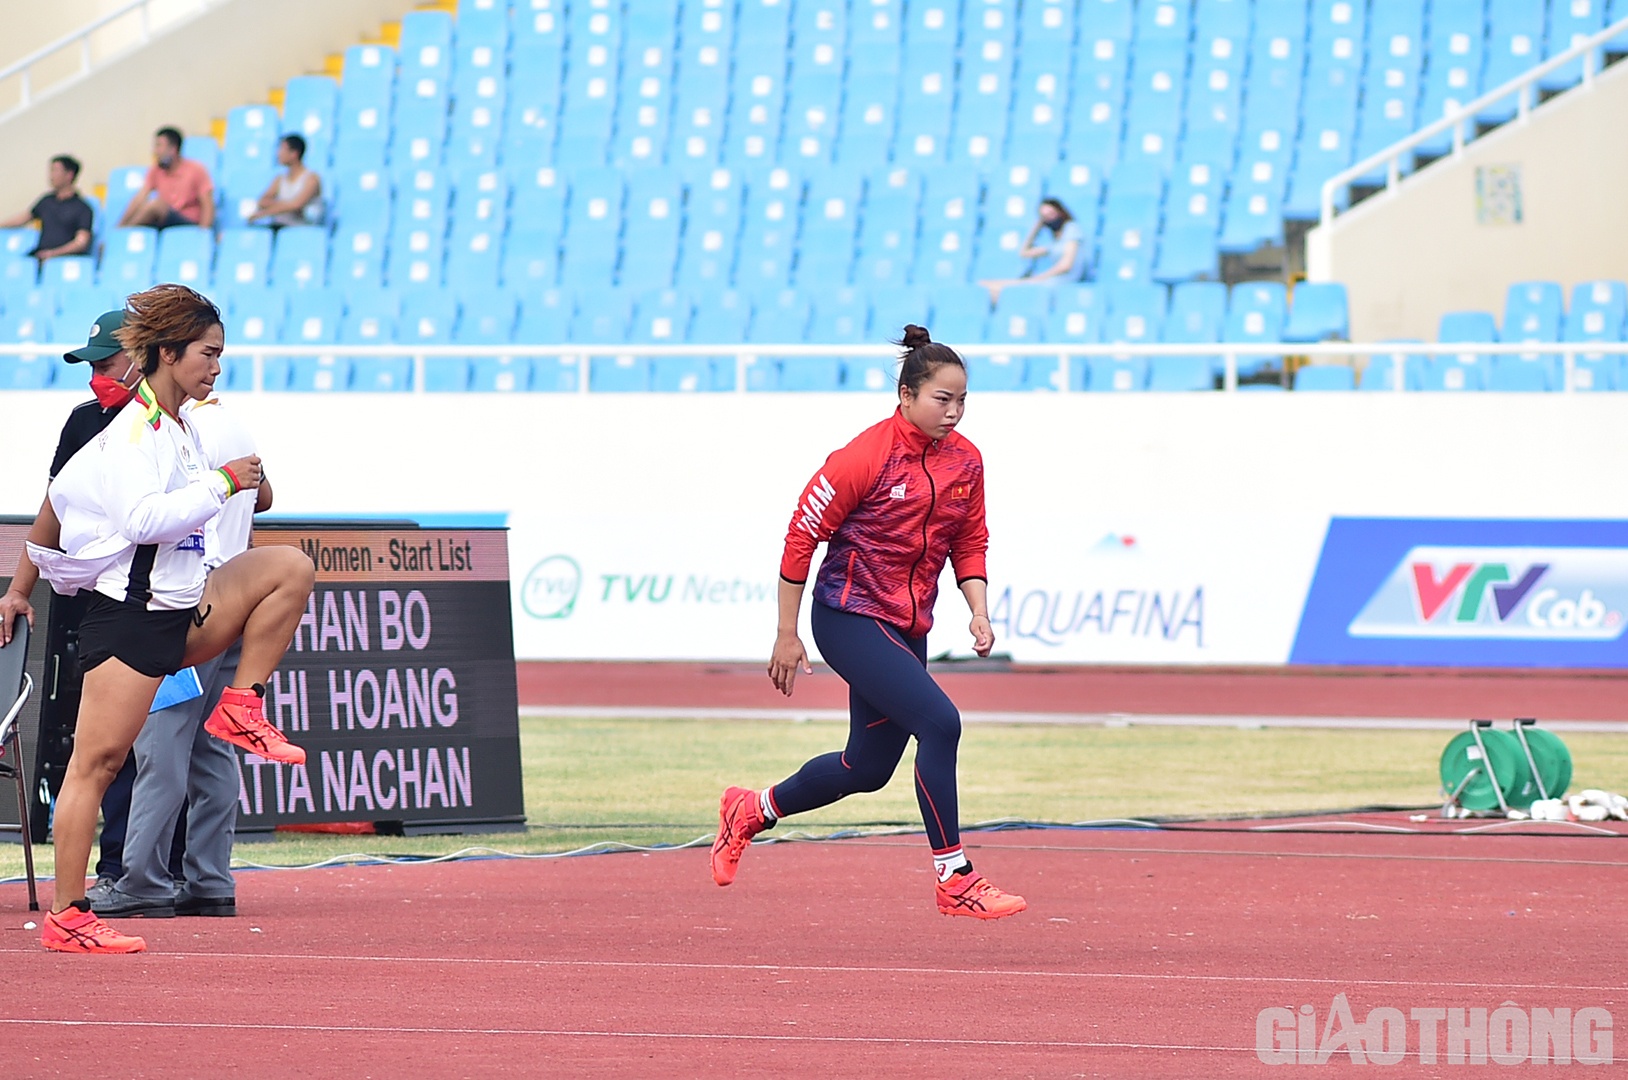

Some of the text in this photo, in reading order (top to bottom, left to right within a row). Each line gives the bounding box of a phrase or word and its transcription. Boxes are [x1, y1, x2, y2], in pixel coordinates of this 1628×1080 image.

[301, 538, 372, 571] Women
[389, 538, 433, 571] Start
[438, 538, 472, 571] List
[600, 574, 673, 603] TVU
[990, 585, 1205, 648] AQUAFINA
[286, 590, 431, 651] HAN BO
[329, 667, 459, 730] HOANG
[321, 747, 473, 812] NACHAN
